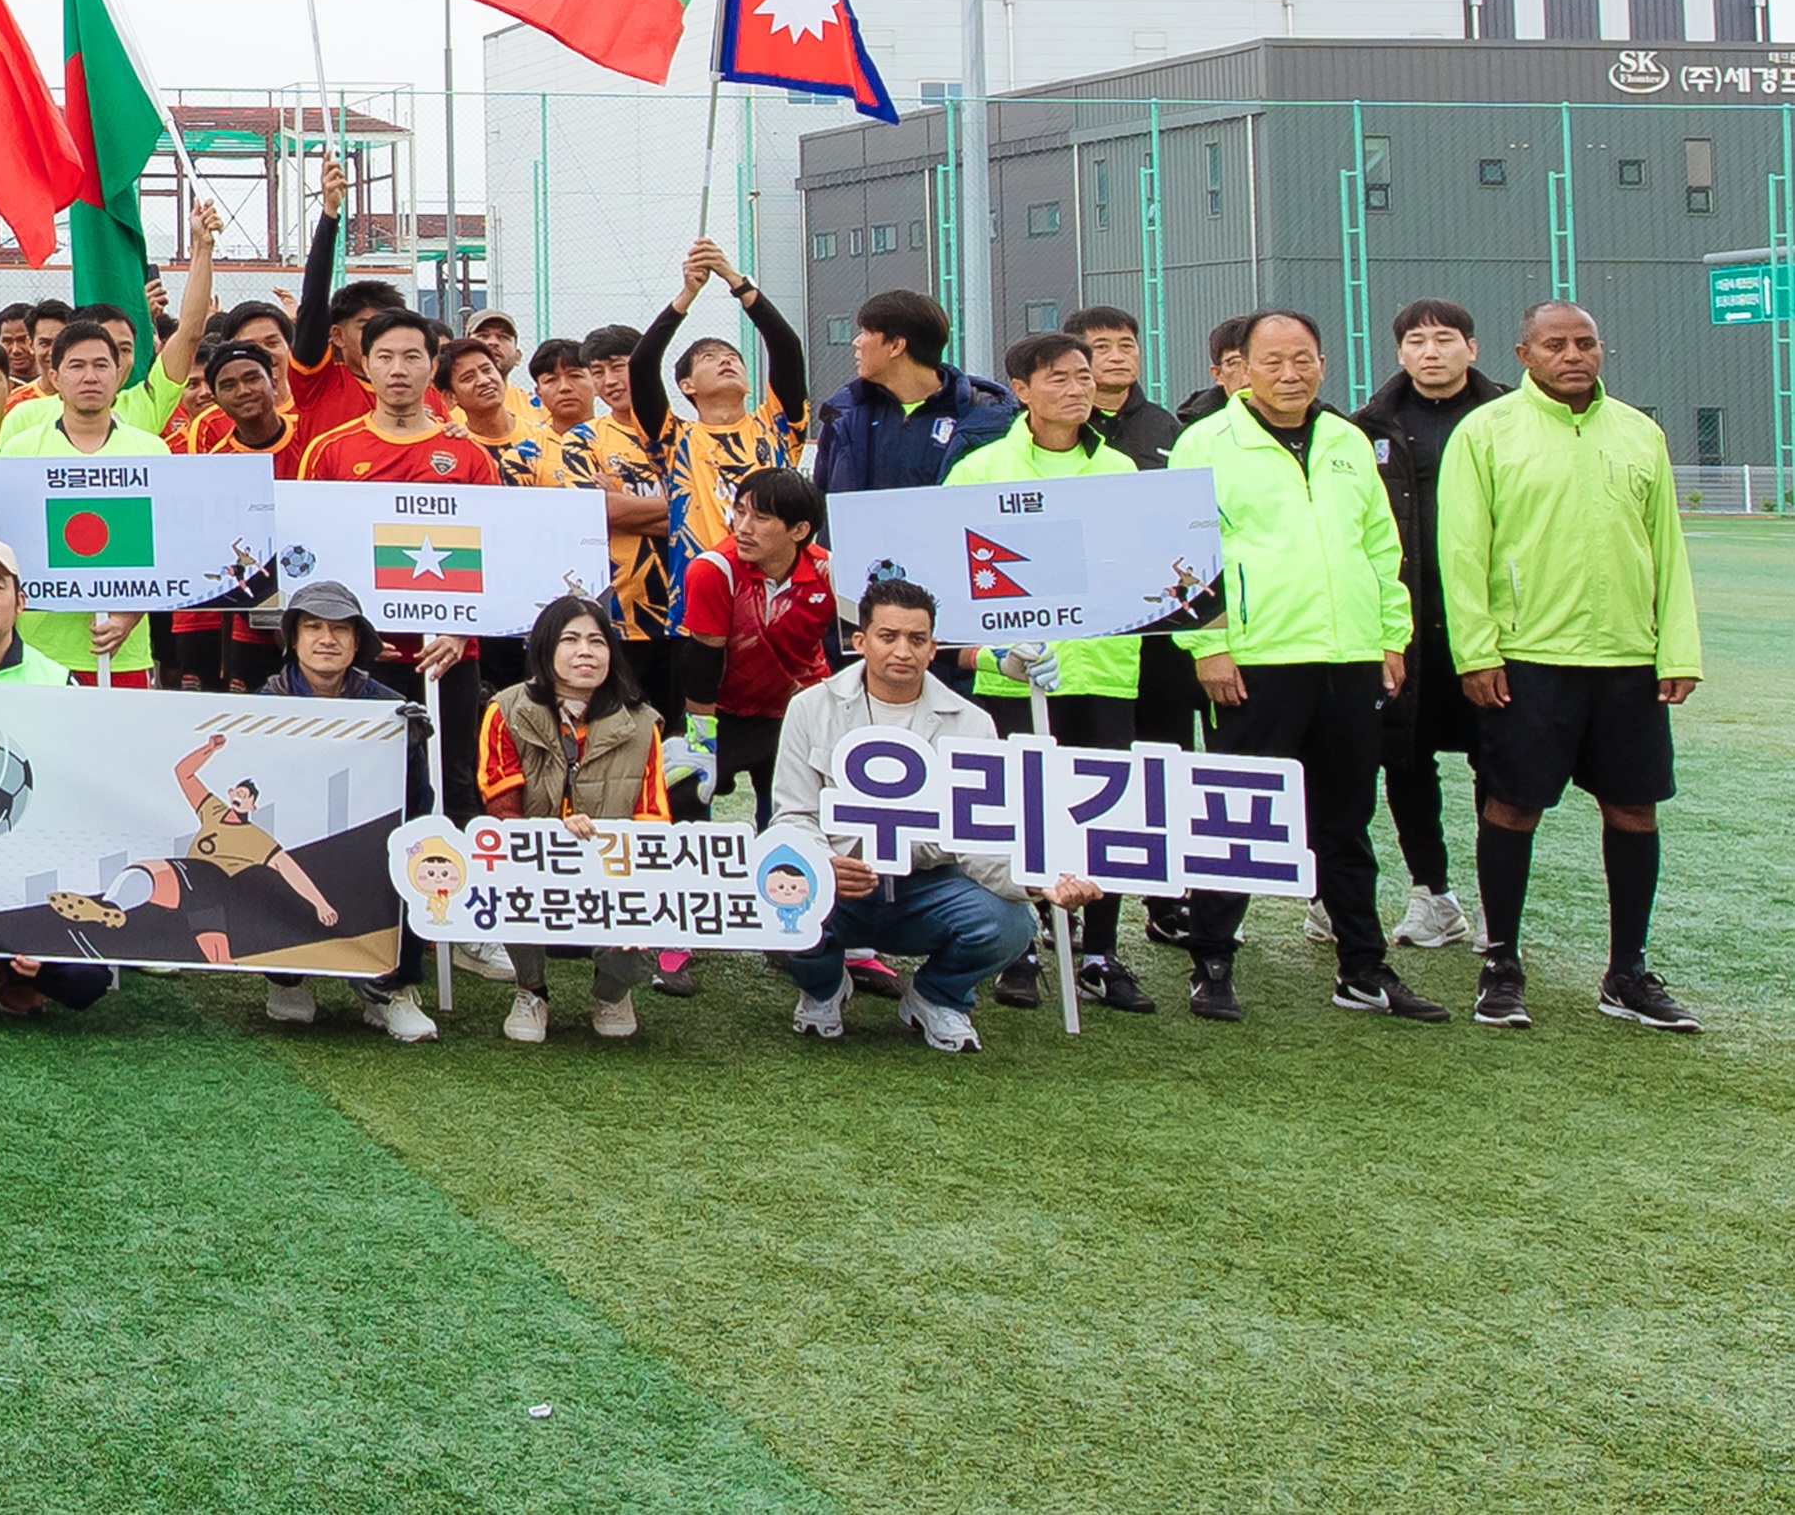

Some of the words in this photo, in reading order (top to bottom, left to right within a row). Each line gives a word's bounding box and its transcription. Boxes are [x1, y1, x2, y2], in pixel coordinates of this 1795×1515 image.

[1619, 51, 1659, 73] SK
[46, 468, 149, 490] 방글라데시
[394, 495, 457, 516] 미얀마
[998, 492, 1045, 515] 네팔
[19, 581, 82, 599] KOREA
[88, 581, 161, 598] JUMMA
[167, 580, 190, 597] FC
[383, 601, 448, 621] GIMPO
[452, 603, 478, 623] FC
[981, 610, 1050, 631] GIMPO
[1057, 607, 1084, 626] FC
[833, 740, 1300, 886] 우리김포
[470, 828, 586, 875] 우리는
[597, 832, 748, 878] 김포시민
[465, 884, 763, 931] 상호문화도시김포
